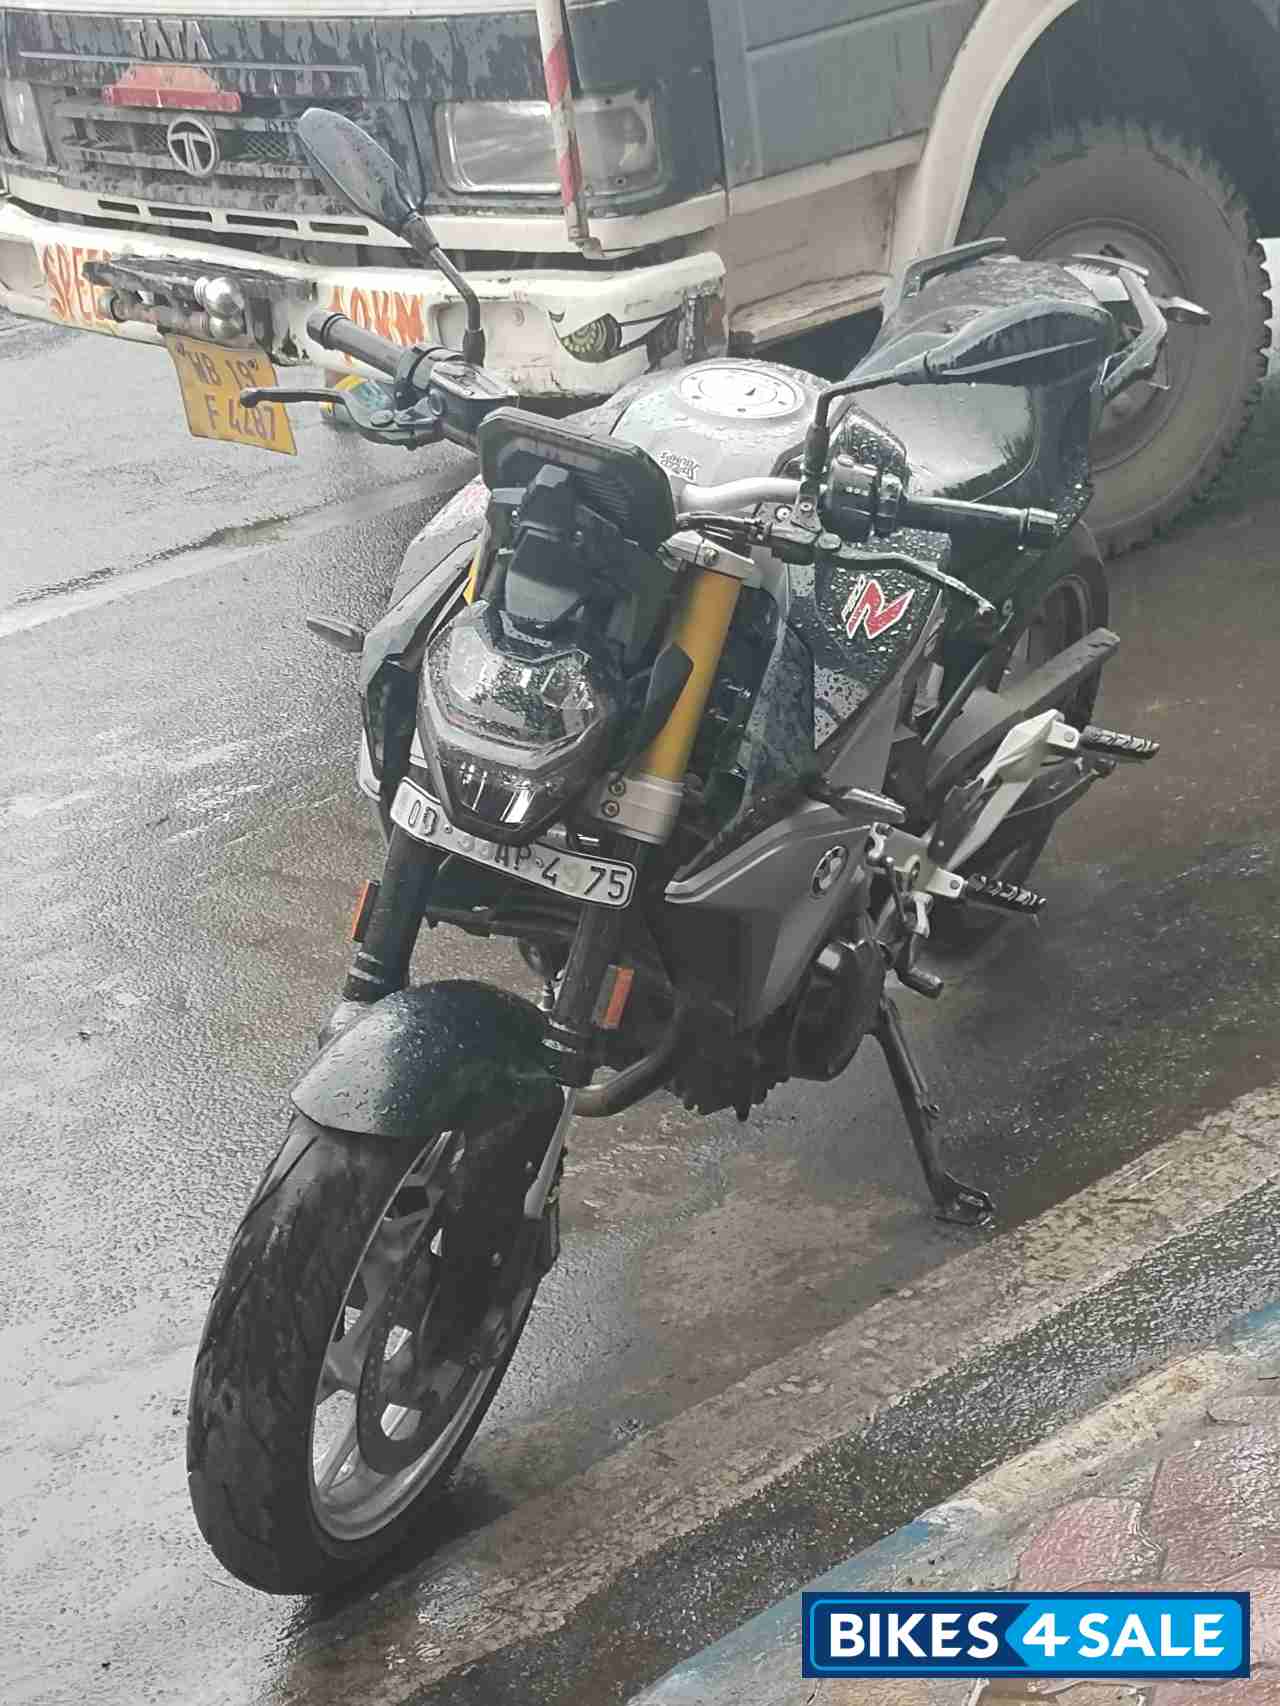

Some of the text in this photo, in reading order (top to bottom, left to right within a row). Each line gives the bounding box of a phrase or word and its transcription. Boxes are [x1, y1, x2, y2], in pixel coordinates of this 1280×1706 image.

[121, 18, 211, 60] TATA
[186, 351, 222, 385] WB
[204, 393, 219, 431] F
